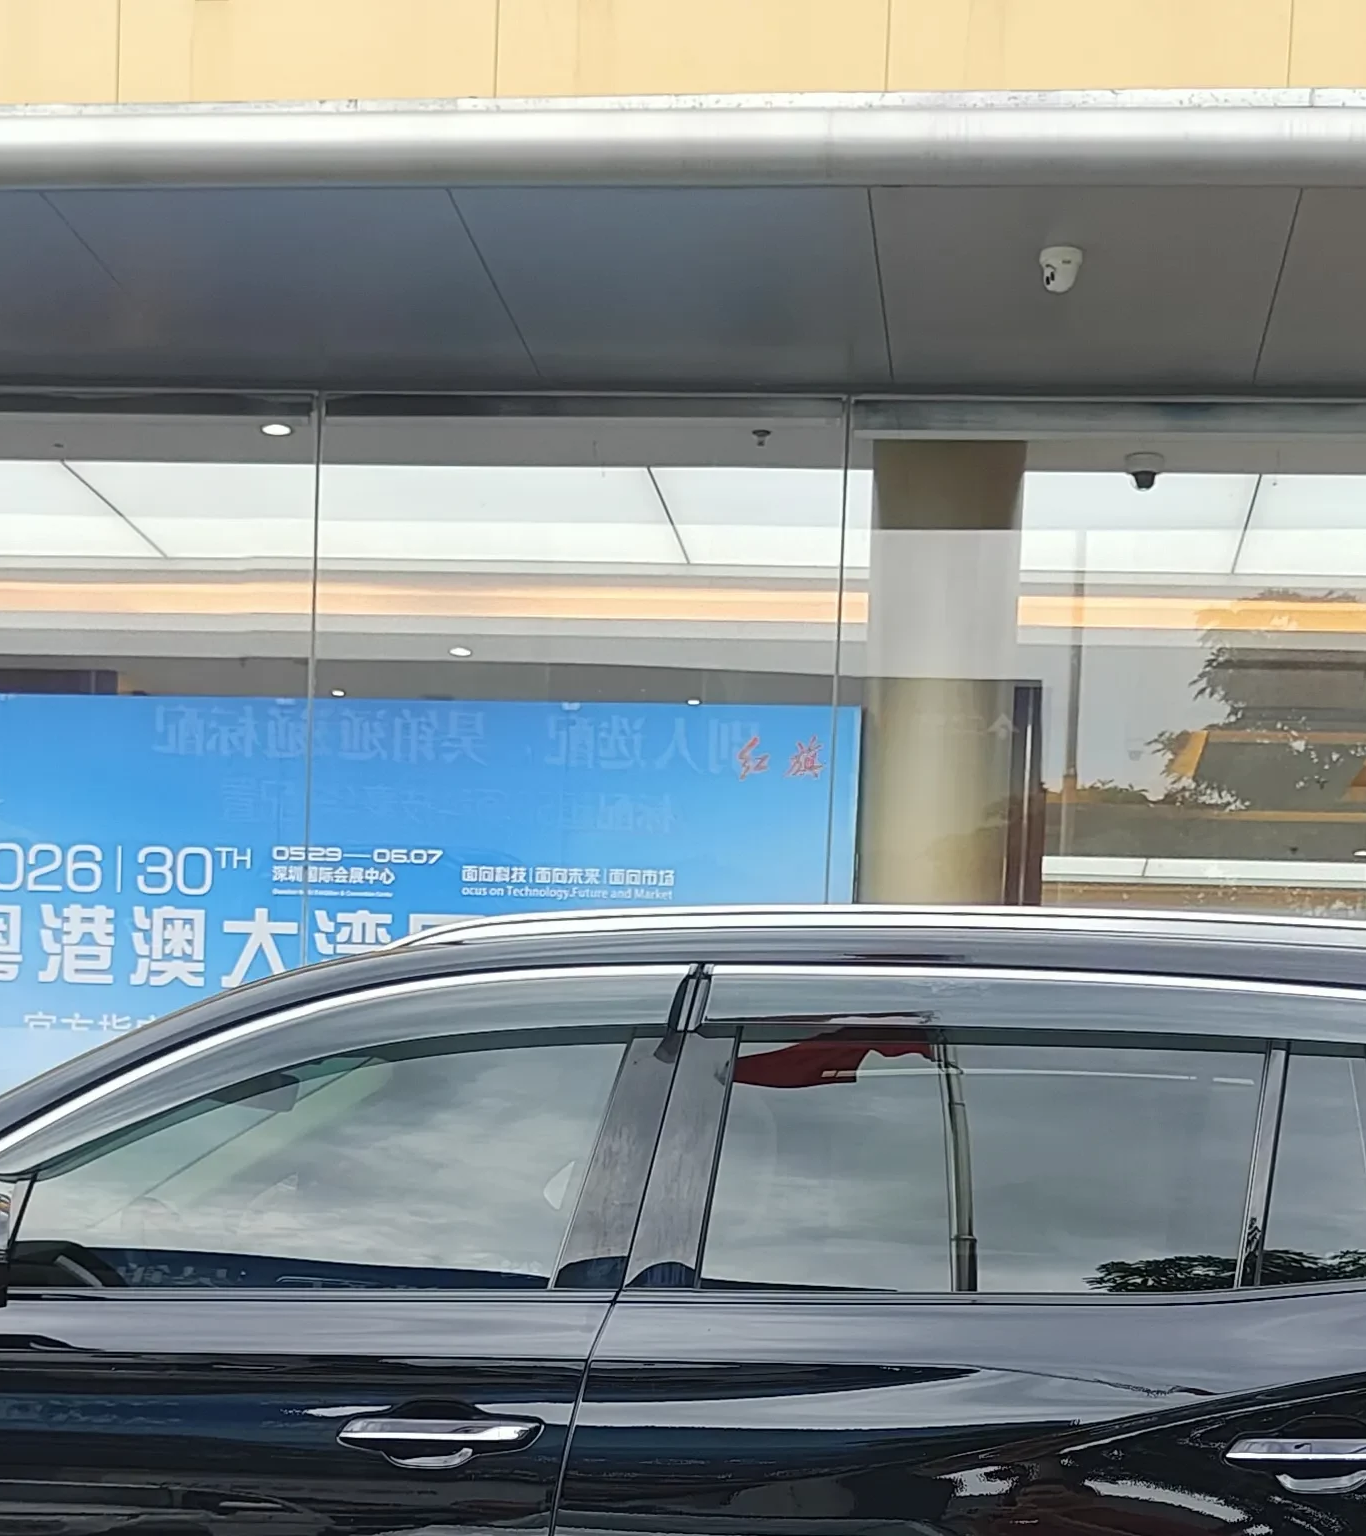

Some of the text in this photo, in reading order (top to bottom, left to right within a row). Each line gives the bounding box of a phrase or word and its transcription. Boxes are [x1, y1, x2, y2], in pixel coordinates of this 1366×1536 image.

[736, 733, 826, 782] 红旗
[136, 845, 252, 896] 30TH
[273, 866, 395, 884] 深圳国际会展中心
[489, 888, 504, 897] on
[610, 889, 632, 900] and
